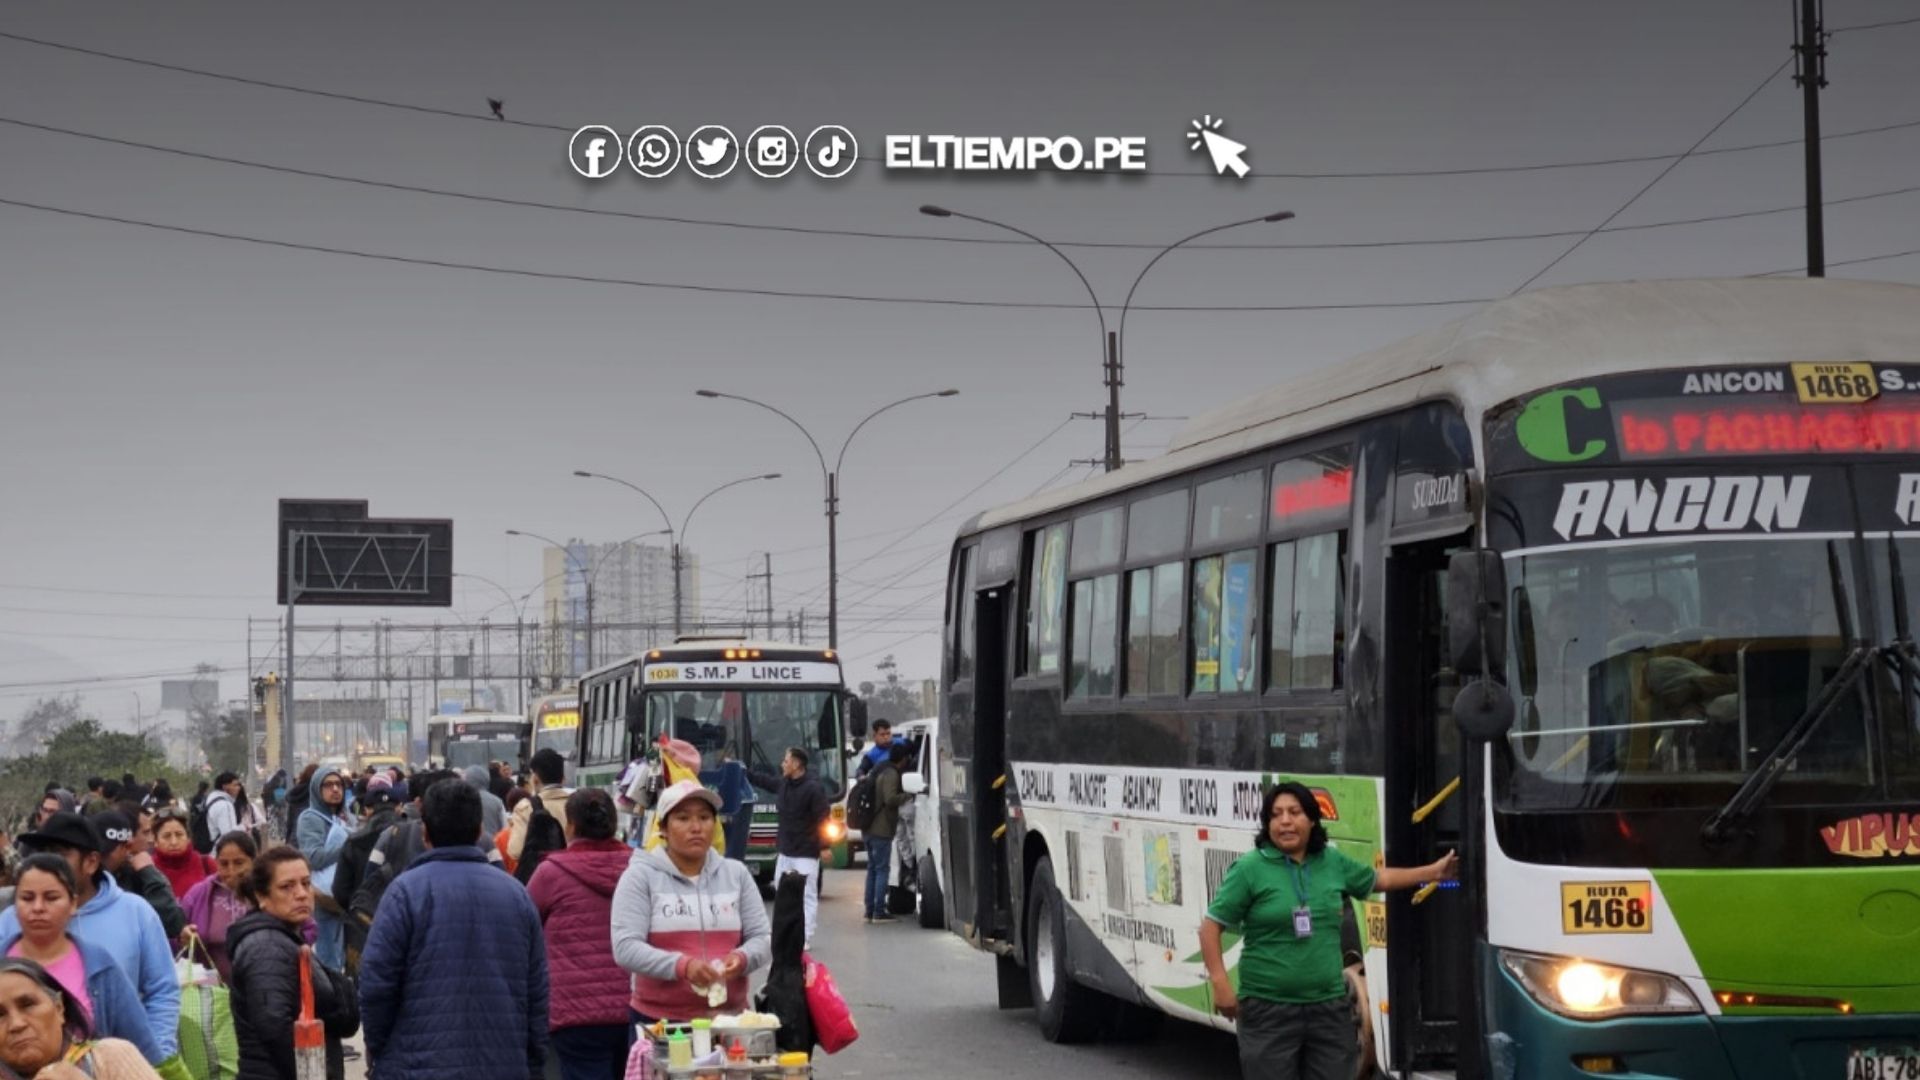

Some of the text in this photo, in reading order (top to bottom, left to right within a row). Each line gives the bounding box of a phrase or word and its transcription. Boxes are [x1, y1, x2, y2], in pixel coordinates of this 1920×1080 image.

[1814, 365, 1853, 374] RUTA
[1682, 371, 1784, 394] ANCON
[1801, 375, 1873, 398] 1468
[1516, 387, 1606, 462] C
[1412, 473, 1459, 510] SUBIDA
[1552, 475, 1811, 541] ANCON
[685, 666, 737, 680] S.M.P
[752, 667, 803, 680] LINCE
[1121, 775, 1162, 812] ABANCAY
[1179, 778, 1219, 817] MEXICO
[1587, 887, 1628, 897] RUTA
[1568, 898, 1645, 928] 1468
[1853, 1056, 1920, 1080] ABI-78
